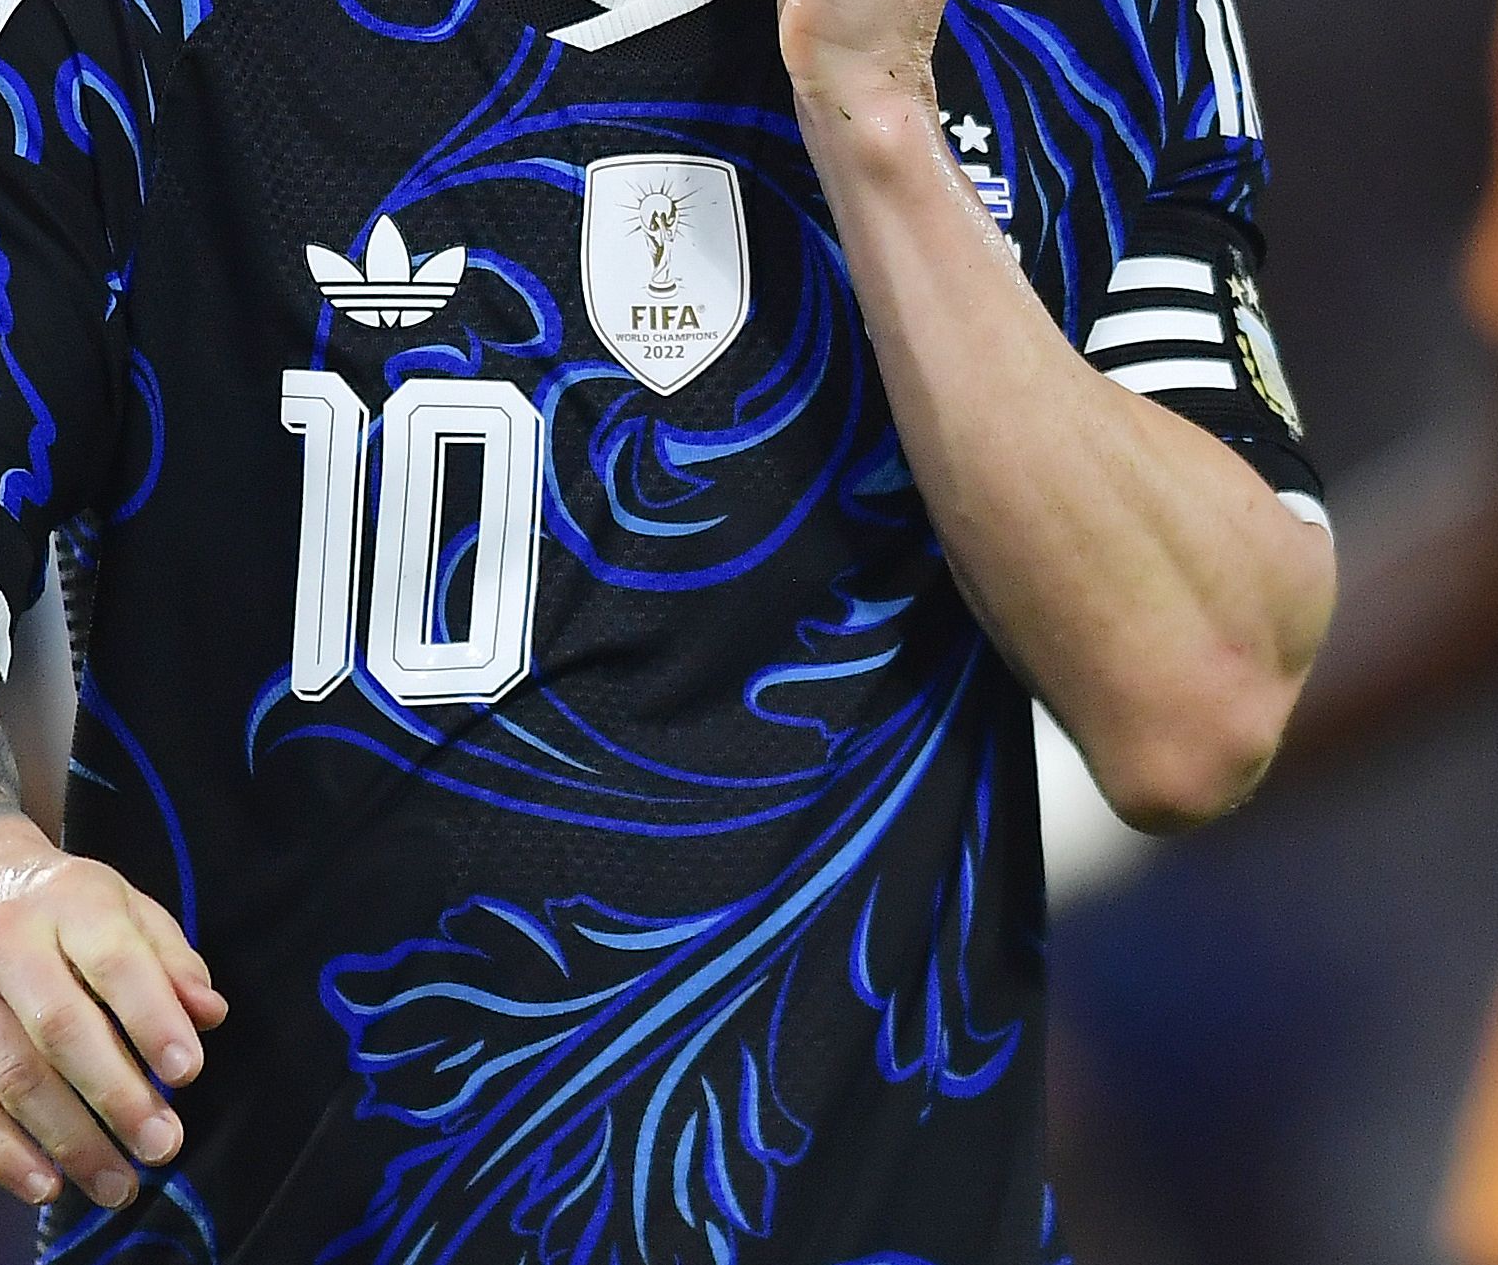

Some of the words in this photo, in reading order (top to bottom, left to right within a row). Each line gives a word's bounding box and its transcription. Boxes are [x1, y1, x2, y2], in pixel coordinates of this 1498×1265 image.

[631, 305, 701, 330] FIFA
[615, 333, 650, 342] WORLD
[652, 331, 719, 342] CHAMPIONS
[643, 345, 685, 359] 2022
[281, 369, 545, 707] 10
